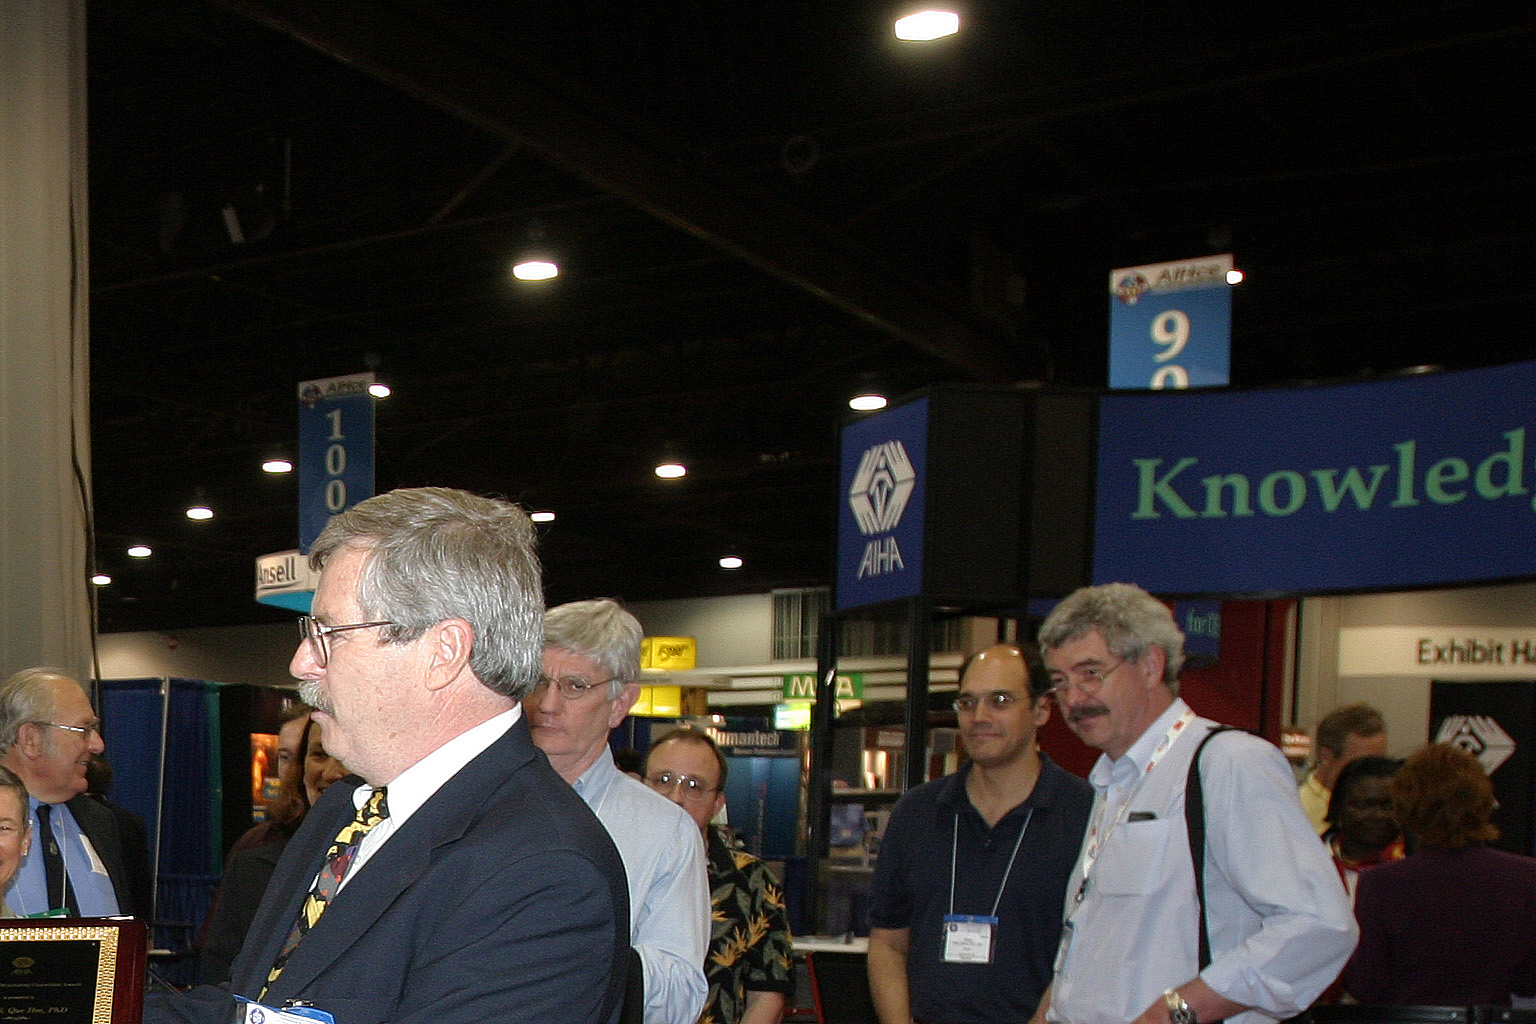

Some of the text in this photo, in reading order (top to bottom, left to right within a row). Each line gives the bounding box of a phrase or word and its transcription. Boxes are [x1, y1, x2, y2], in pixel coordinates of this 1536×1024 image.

[1130, 427, 1536, 519] Knowled
[857, 536, 904, 581] AIHA
[1417, 638, 1503, 665] Exhibit
[790, 676, 854, 697] MA
